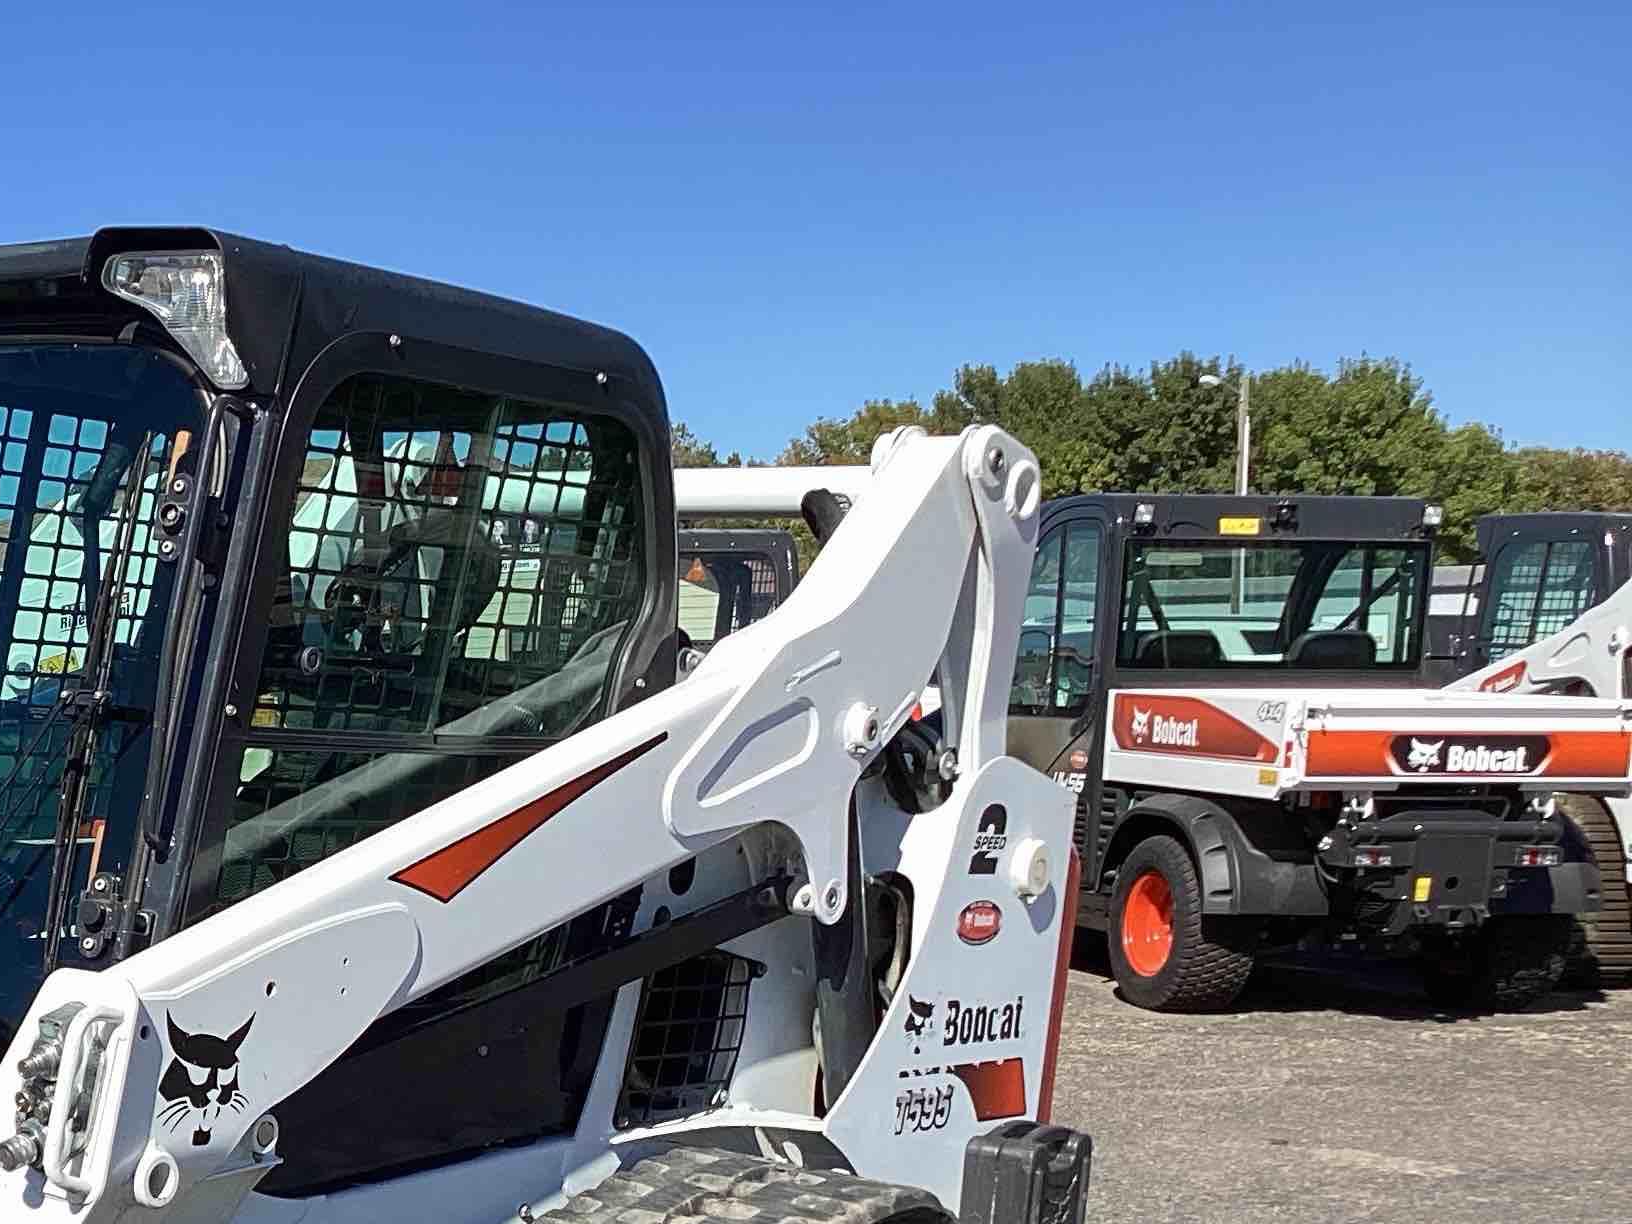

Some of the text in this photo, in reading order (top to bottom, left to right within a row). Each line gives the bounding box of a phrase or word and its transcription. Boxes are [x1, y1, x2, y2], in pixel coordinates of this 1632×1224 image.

[1152, 714, 1199, 747] Bobcat
[1446, 745, 1528, 772] Bobcat
[968, 803, 1007, 874] 2
[974, 836, 1007, 850] SPEED
[944, 995, 1023, 1046] Bobcat
[895, 1083, 954, 1135] T595
